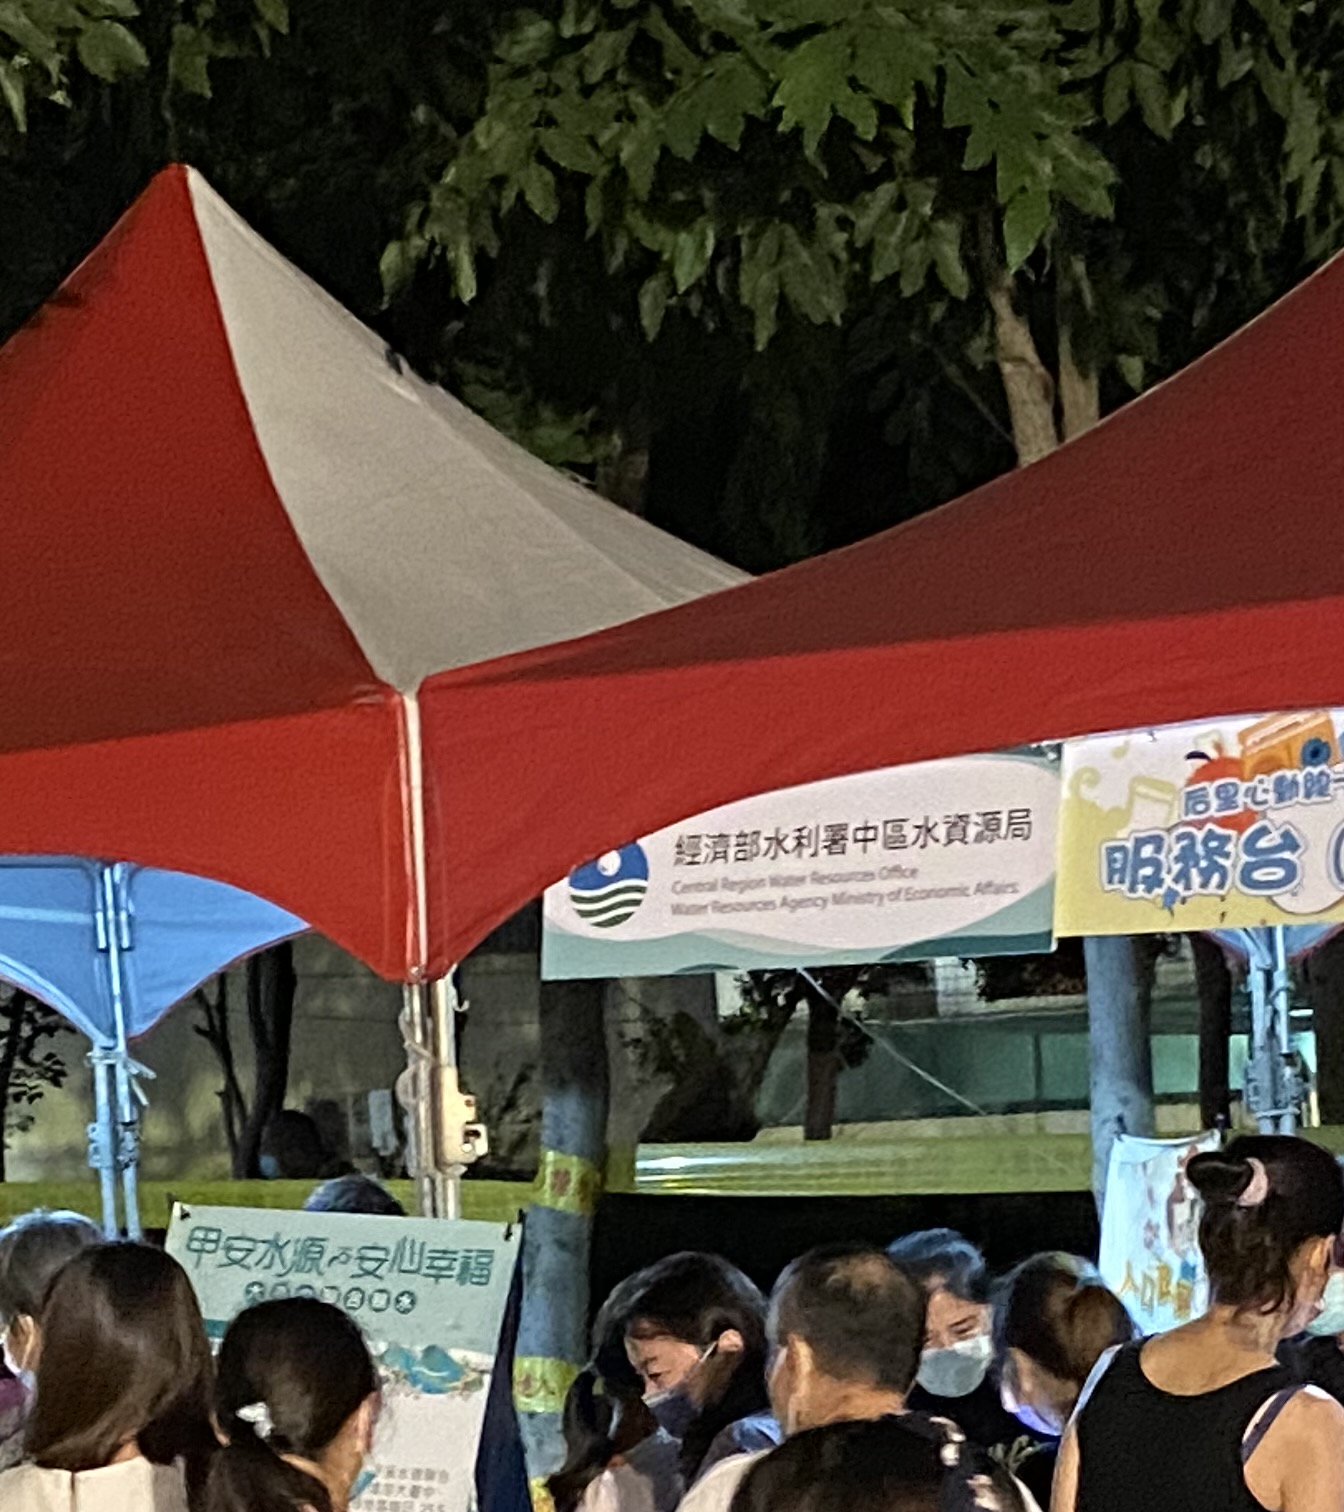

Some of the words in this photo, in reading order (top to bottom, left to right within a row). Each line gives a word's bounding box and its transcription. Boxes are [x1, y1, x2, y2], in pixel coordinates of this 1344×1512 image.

[673, 808, 1033, 867] 經濟部水利署中區水資源局
[671, 902, 707, 916] Water
[711, 899, 776, 914] Resources
[779, 896, 828, 911] Agency
[831, 890, 884, 908] Ministry
[887, 889, 902, 902] of
[905, 885, 970, 901] Economic
[973, 880, 1019, 896] Affairs
[672, 879, 717, 895] Central
[721, 876, 766, 894] Region
[769, 873, 807, 887] Water
[810, 870, 875, 884] Resources
[878, 864, 918, 880] Office
[186, 1226, 328, 1278] 甲安水源
[351, 1236, 495, 1287] 安心幸福
